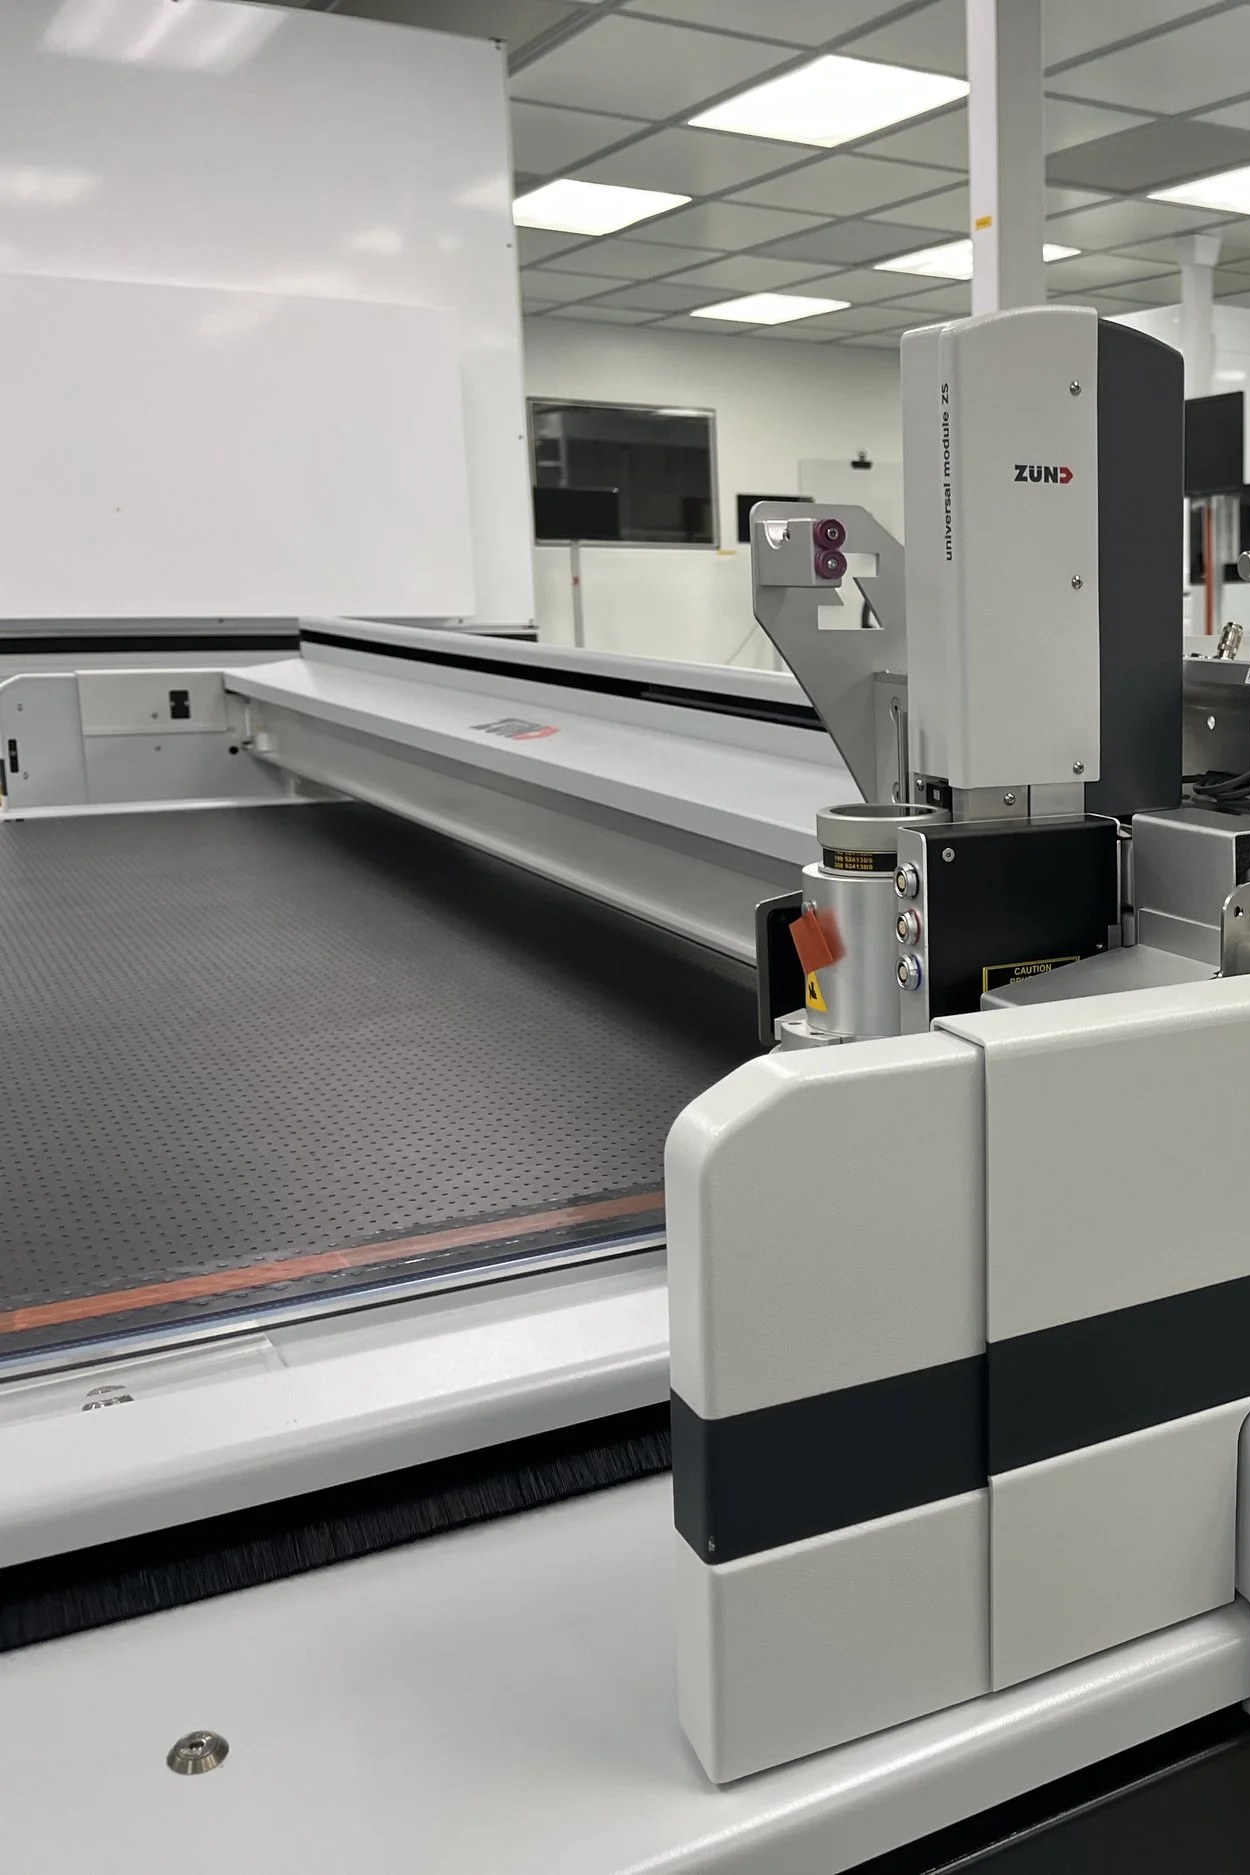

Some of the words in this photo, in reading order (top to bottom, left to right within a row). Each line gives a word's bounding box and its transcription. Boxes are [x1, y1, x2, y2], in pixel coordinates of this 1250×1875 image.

[942, 411, 951, 477] module
[943, 482, 953, 561] universal
[1014, 963, 1052, 976] CAUTION
